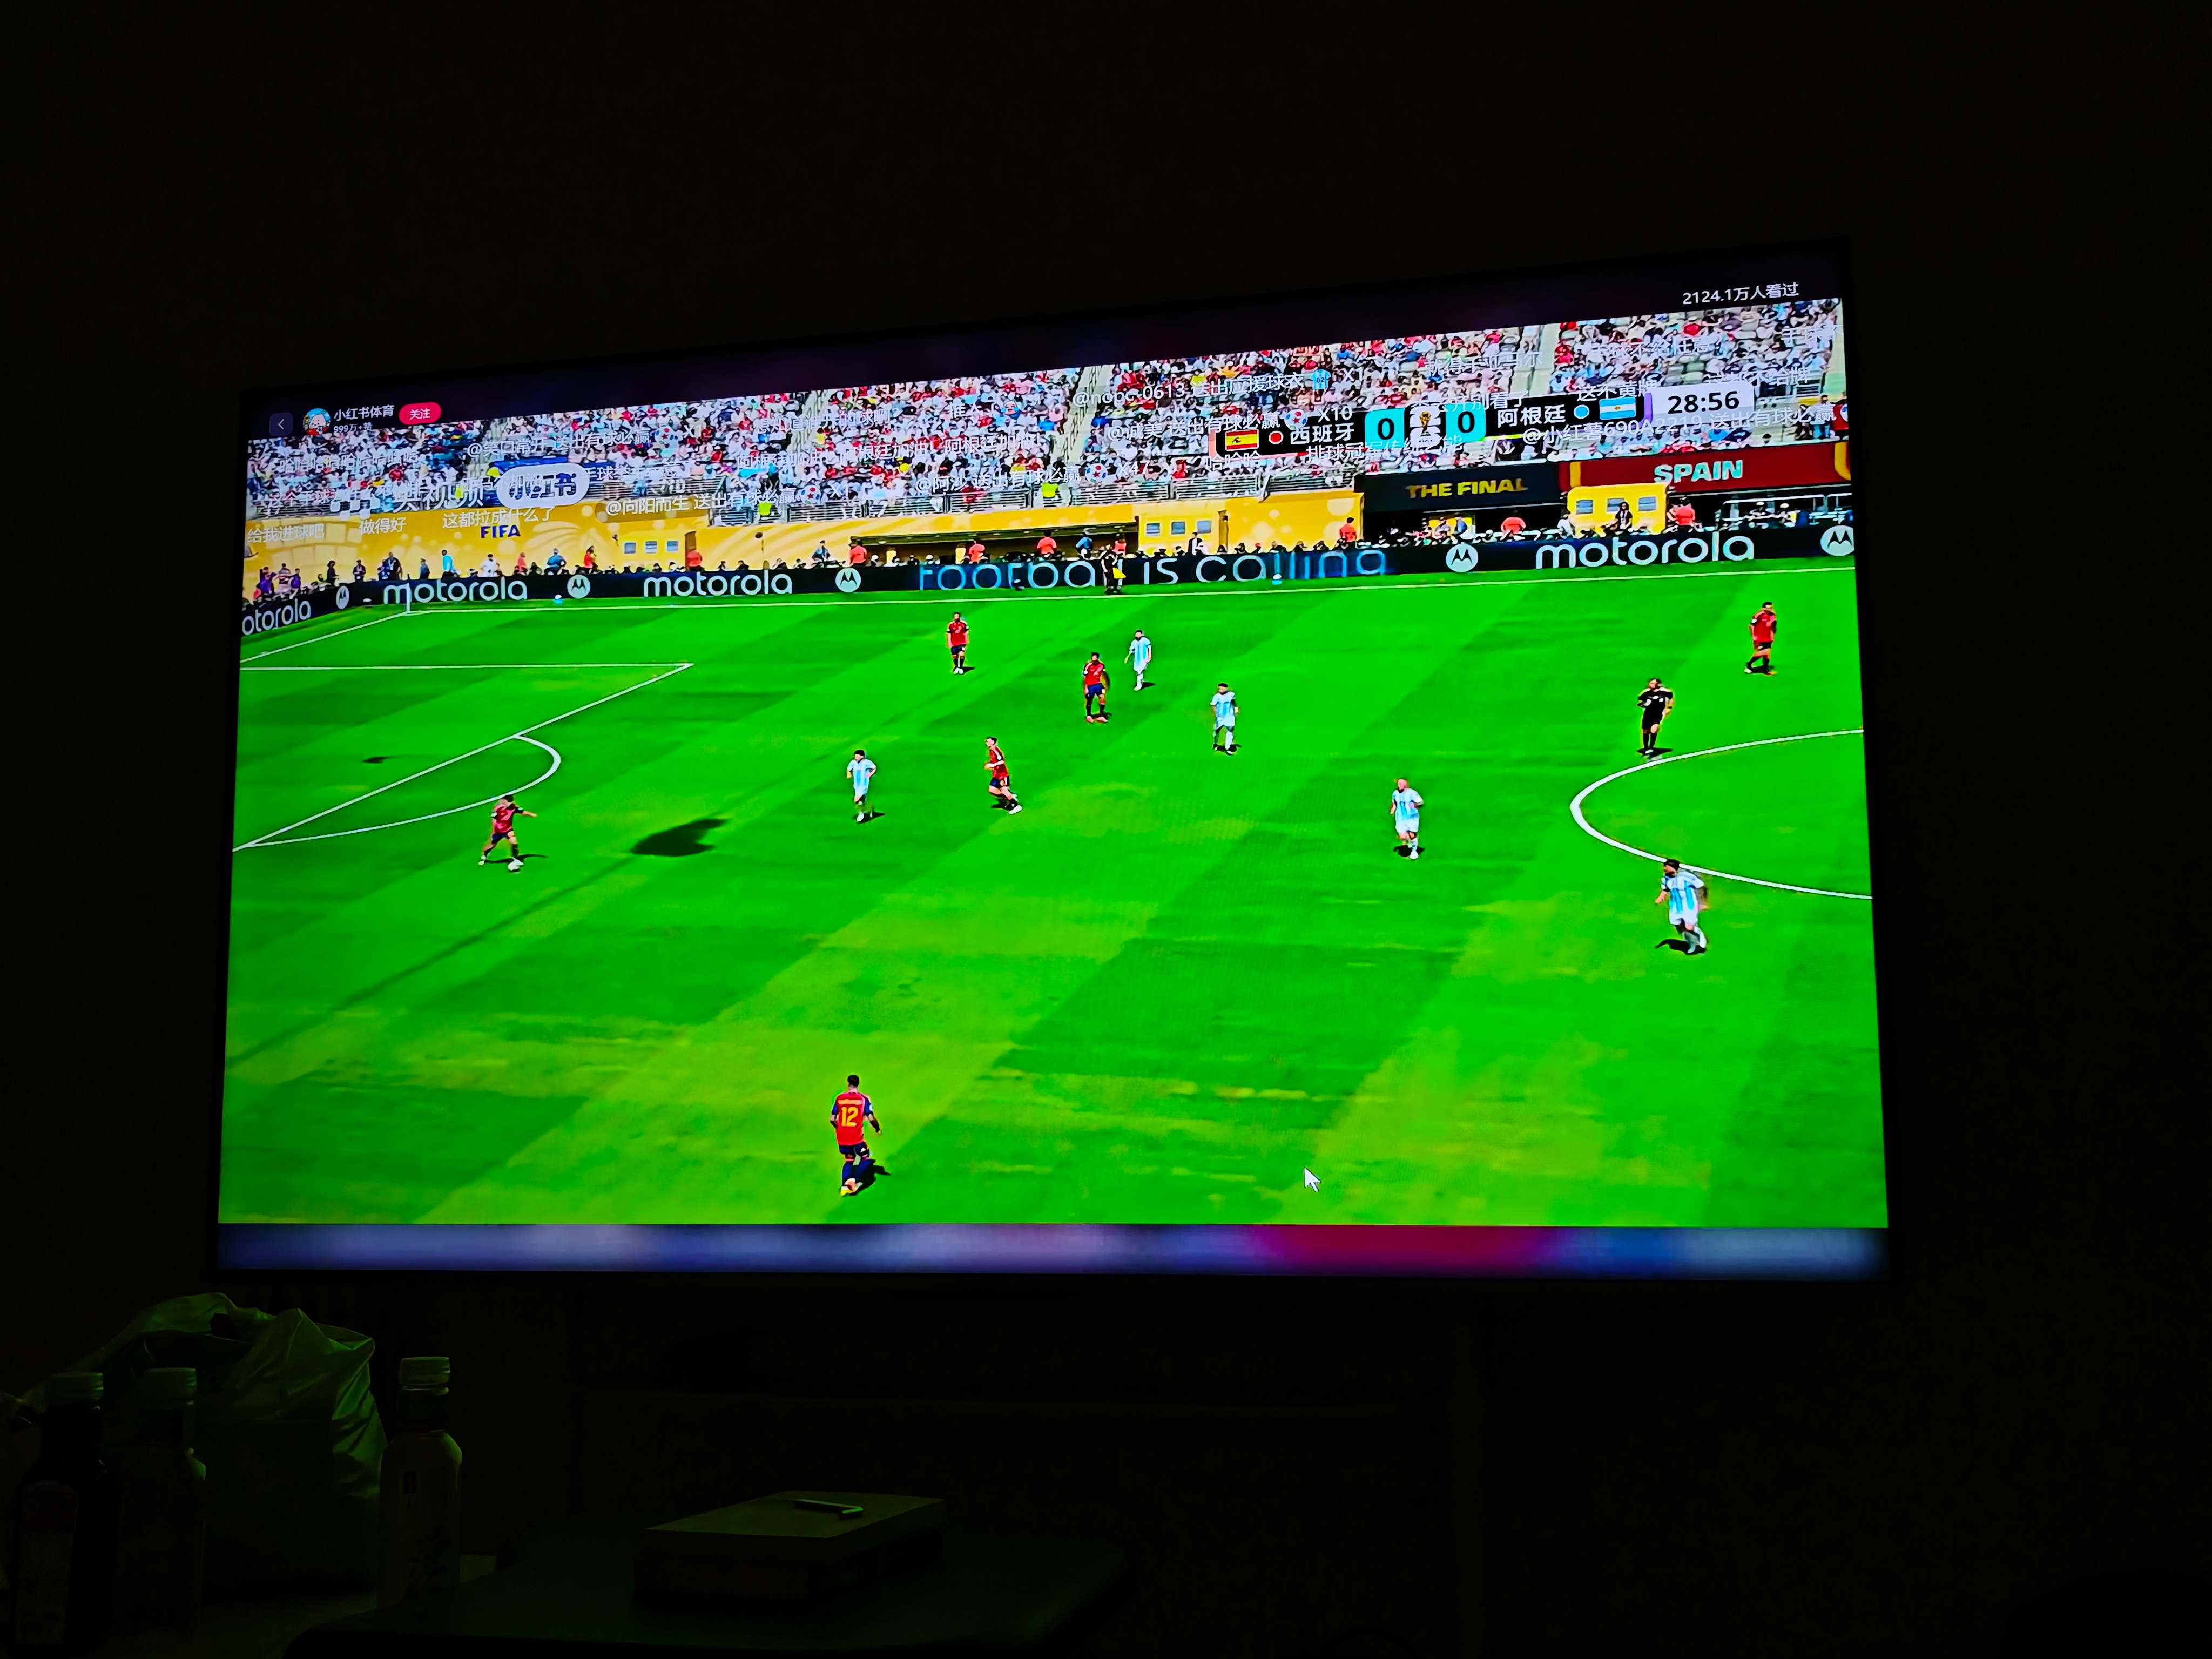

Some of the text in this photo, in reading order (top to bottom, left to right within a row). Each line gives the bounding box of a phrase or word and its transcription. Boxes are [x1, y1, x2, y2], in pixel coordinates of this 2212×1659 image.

[1682, 282, 1799, 305] 2124.1万人看过
[1191, 372, 1305, 398] 送出应援球衣
[333, 404, 395, 422] 小红书体育
[409, 408, 431, 421] 关注
[1668, 390, 1739, 415] 28:56
[333, 421, 373, 433] 999万+赞
[1107, 407, 1353, 442] @诚美 送出有球必赢 X10
[1458, 411, 1475, 434] 0
[1496, 404, 1566, 428] 阿根廷
[1522, 404, 1837, 446] @小红薯690A2219 送出有球必赢
[1290, 422, 1355, 445] 西班牙
[1377, 417, 1395, 440] 0
[467, 437, 547, 458] @笑口常开
[552, 429, 651, 451] 送出有球必赢
[972, 466, 1082, 490] 送出有球必赢
[1117, 460, 1151, 477] X47
[1654, 460, 1743, 485] SPAIN
[509, 471, 577, 500] 小红书
[1406, 478, 1529, 499] THE FINAL
[606, 495, 690, 516] @向阳而生
[693, 487, 797, 510] 送出有球必赢
[359, 517, 407, 535] 做得好
[442, 505, 556, 529] 这都拉成什么了
[247, 523, 325, 544] 给我进球吧
[480, 524, 521, 539] FIFA
[1536, 531, 1755, 570] motorola
[383, 577, 528, 605] motorola
[644, 569, 793, 598] motorola
[841, 1106, 859, 1127] 12
